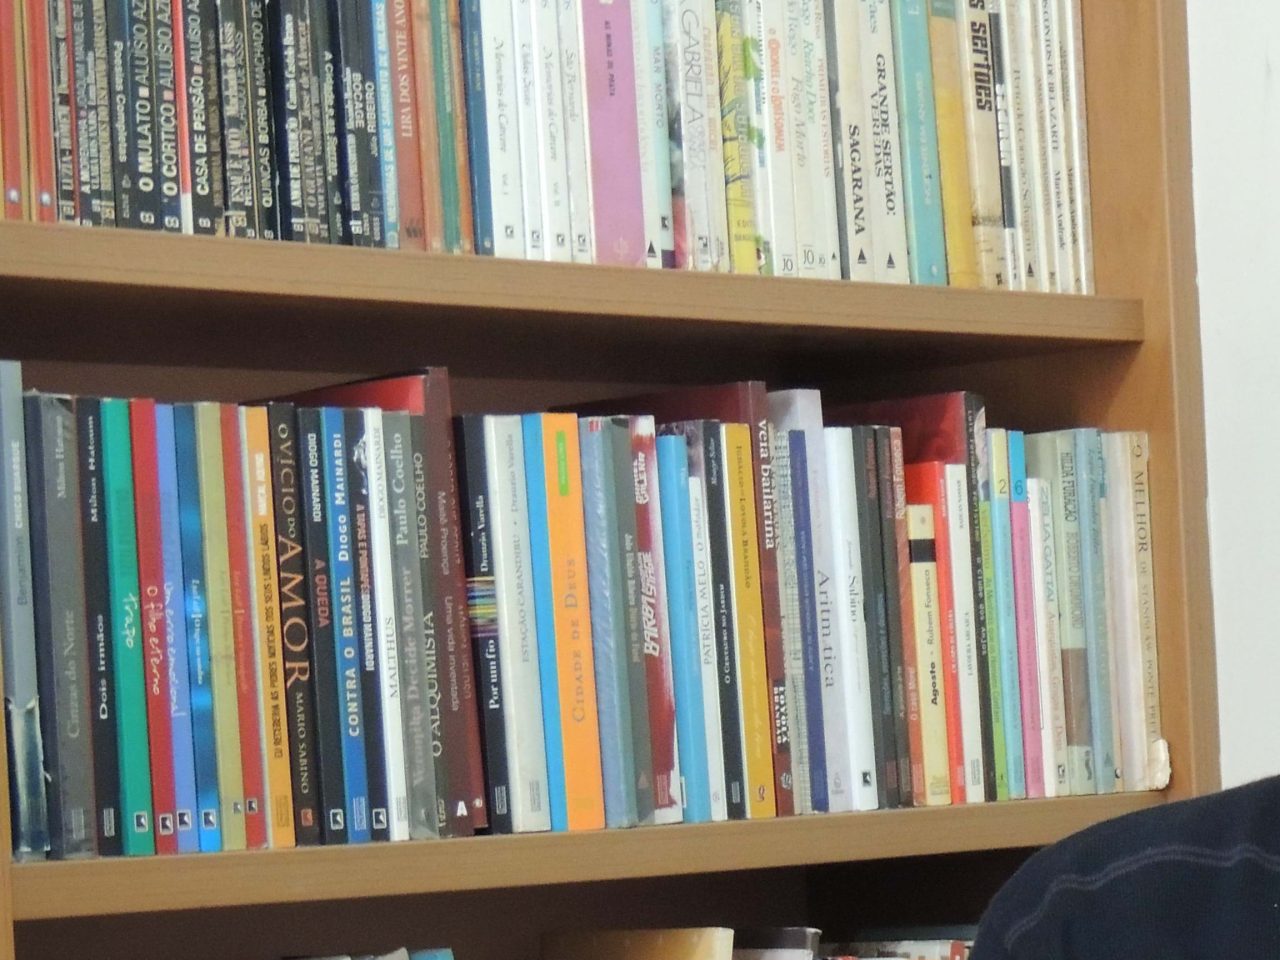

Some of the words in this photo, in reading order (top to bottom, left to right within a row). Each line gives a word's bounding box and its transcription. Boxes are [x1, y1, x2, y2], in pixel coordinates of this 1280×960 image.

[251, 2, 263, 18] DE
[133, 24, 149, 85] ALUÍSIO
[157, 28, 173, 88] ALUÍSIO
[188, 16, 203, 64] ALUÍSIO
[252, 22, 266, 86] MACHADO
[653, 46, 661, 73] MAR
[682, 9, 704, 124] GABRIELA
[190, 76, 206, 131] PENSÃO
[655, 83, 665, 128] MORTO
[875, 54, 891, 134] GRANDE
[136, 100, 153, 173] MULATO
[160, 104, 176, 177] CORTIÇO
[193, 135, 207, 153] DE
[257, 99, 270, 143] BORBA
[870, 92, 884, 177] VEREDAS
[140, 178, 153, 191] O
[163, 182, 177, 195] O
[194, 158, 209, 195] CASA
[260, 148, 273, 207] QUINCAS
[849, 124, 866, 235] SAGARANA
[881, 139, 896, 216] SERTÃO:
[85, 415, 98, 470] Hatoum
[278, 424, 288, 438] O
[308, 434, 318, 465] DIOGO
[275, 444, 296, 515] VÍCIO
[332, 433, 346, 505] MAINARDI
[391, 433, 408, 494] Coelho
[413, 452, 425, 511] COELHO
[891, 439, 903, 479] Fonseca
[1061, 452, 1074, 477] HILDA
[88, 476, 100, 522] Milton
[310, 469, 321, 522] MAINARDI
[437, 492, 448, 528] Maitê
[475, 495, 486, 529] Varella
[692, 496, 704, 540] matador
[894, 482, 905, 519] Rubem
[288, 517, 295, 539] DO
[336, 514, 349, 561] DIOGO
[395, 500, 411, 545] Paulo
[418, 516, 429, 559] PAULO
[315, 559, 326, 571] A
[438, 531, 451, 575] Proença
[479, 532, 489, 572] Drauzio
[694, 543, 704, 552] O
[1066, 531, 1079, 573] ROBERTO
[146, 586, 156, 596] O
[316, 576, 329, 628] QUEDA
[399, 566, 416, 632] Morrer
[563, 558, 578, 609] DEUS
[695, 560, 708, 600] MELO
[848, 575, 860, 623] Sabino
[923, 569, 933, 607] Fonseca
[1067, 573, 1083, 629] DRUMMOND
[122, 594, 138, 648] trapo
[143, 603, 161, 631] filho
[279, 534, 309, 690] AMOR
[340, 577, 353, 637] BRASIL
[444, 596, 454, 624] Uma
[569, 620, 580, 640] DE
[925, 609, 935, 645] Rubem
[94, 614, 107, 671] irmãos
[344, 647, 355, 658] O
[385, 616, 398, 698] MALTHUS
[446, 628, 456, 651] vida
[485, 639, 498, 658] fio
[697, 604, 713, 665] PATRÍCIA
[149, 638, 163, 695] eterno
[403, 637, 420, 699] Decide
[422, 611, 441, 736] ALQUIMISTA
[448, 653, 460, 711] inventada
[488, 661, 497, 682] um
[570, 649, 587, 722] CIDADE
[928, 661, 940, 706] Agosto
[97, 678, 109, 719] Dois
[295, 692, 306, 740] MARIO
[346, 666, 359, 736] CONTRA
[488, 686, 500, 709] Por
[299, 743, 310, 794] SABINO
[430, 740, 443, 757] O
